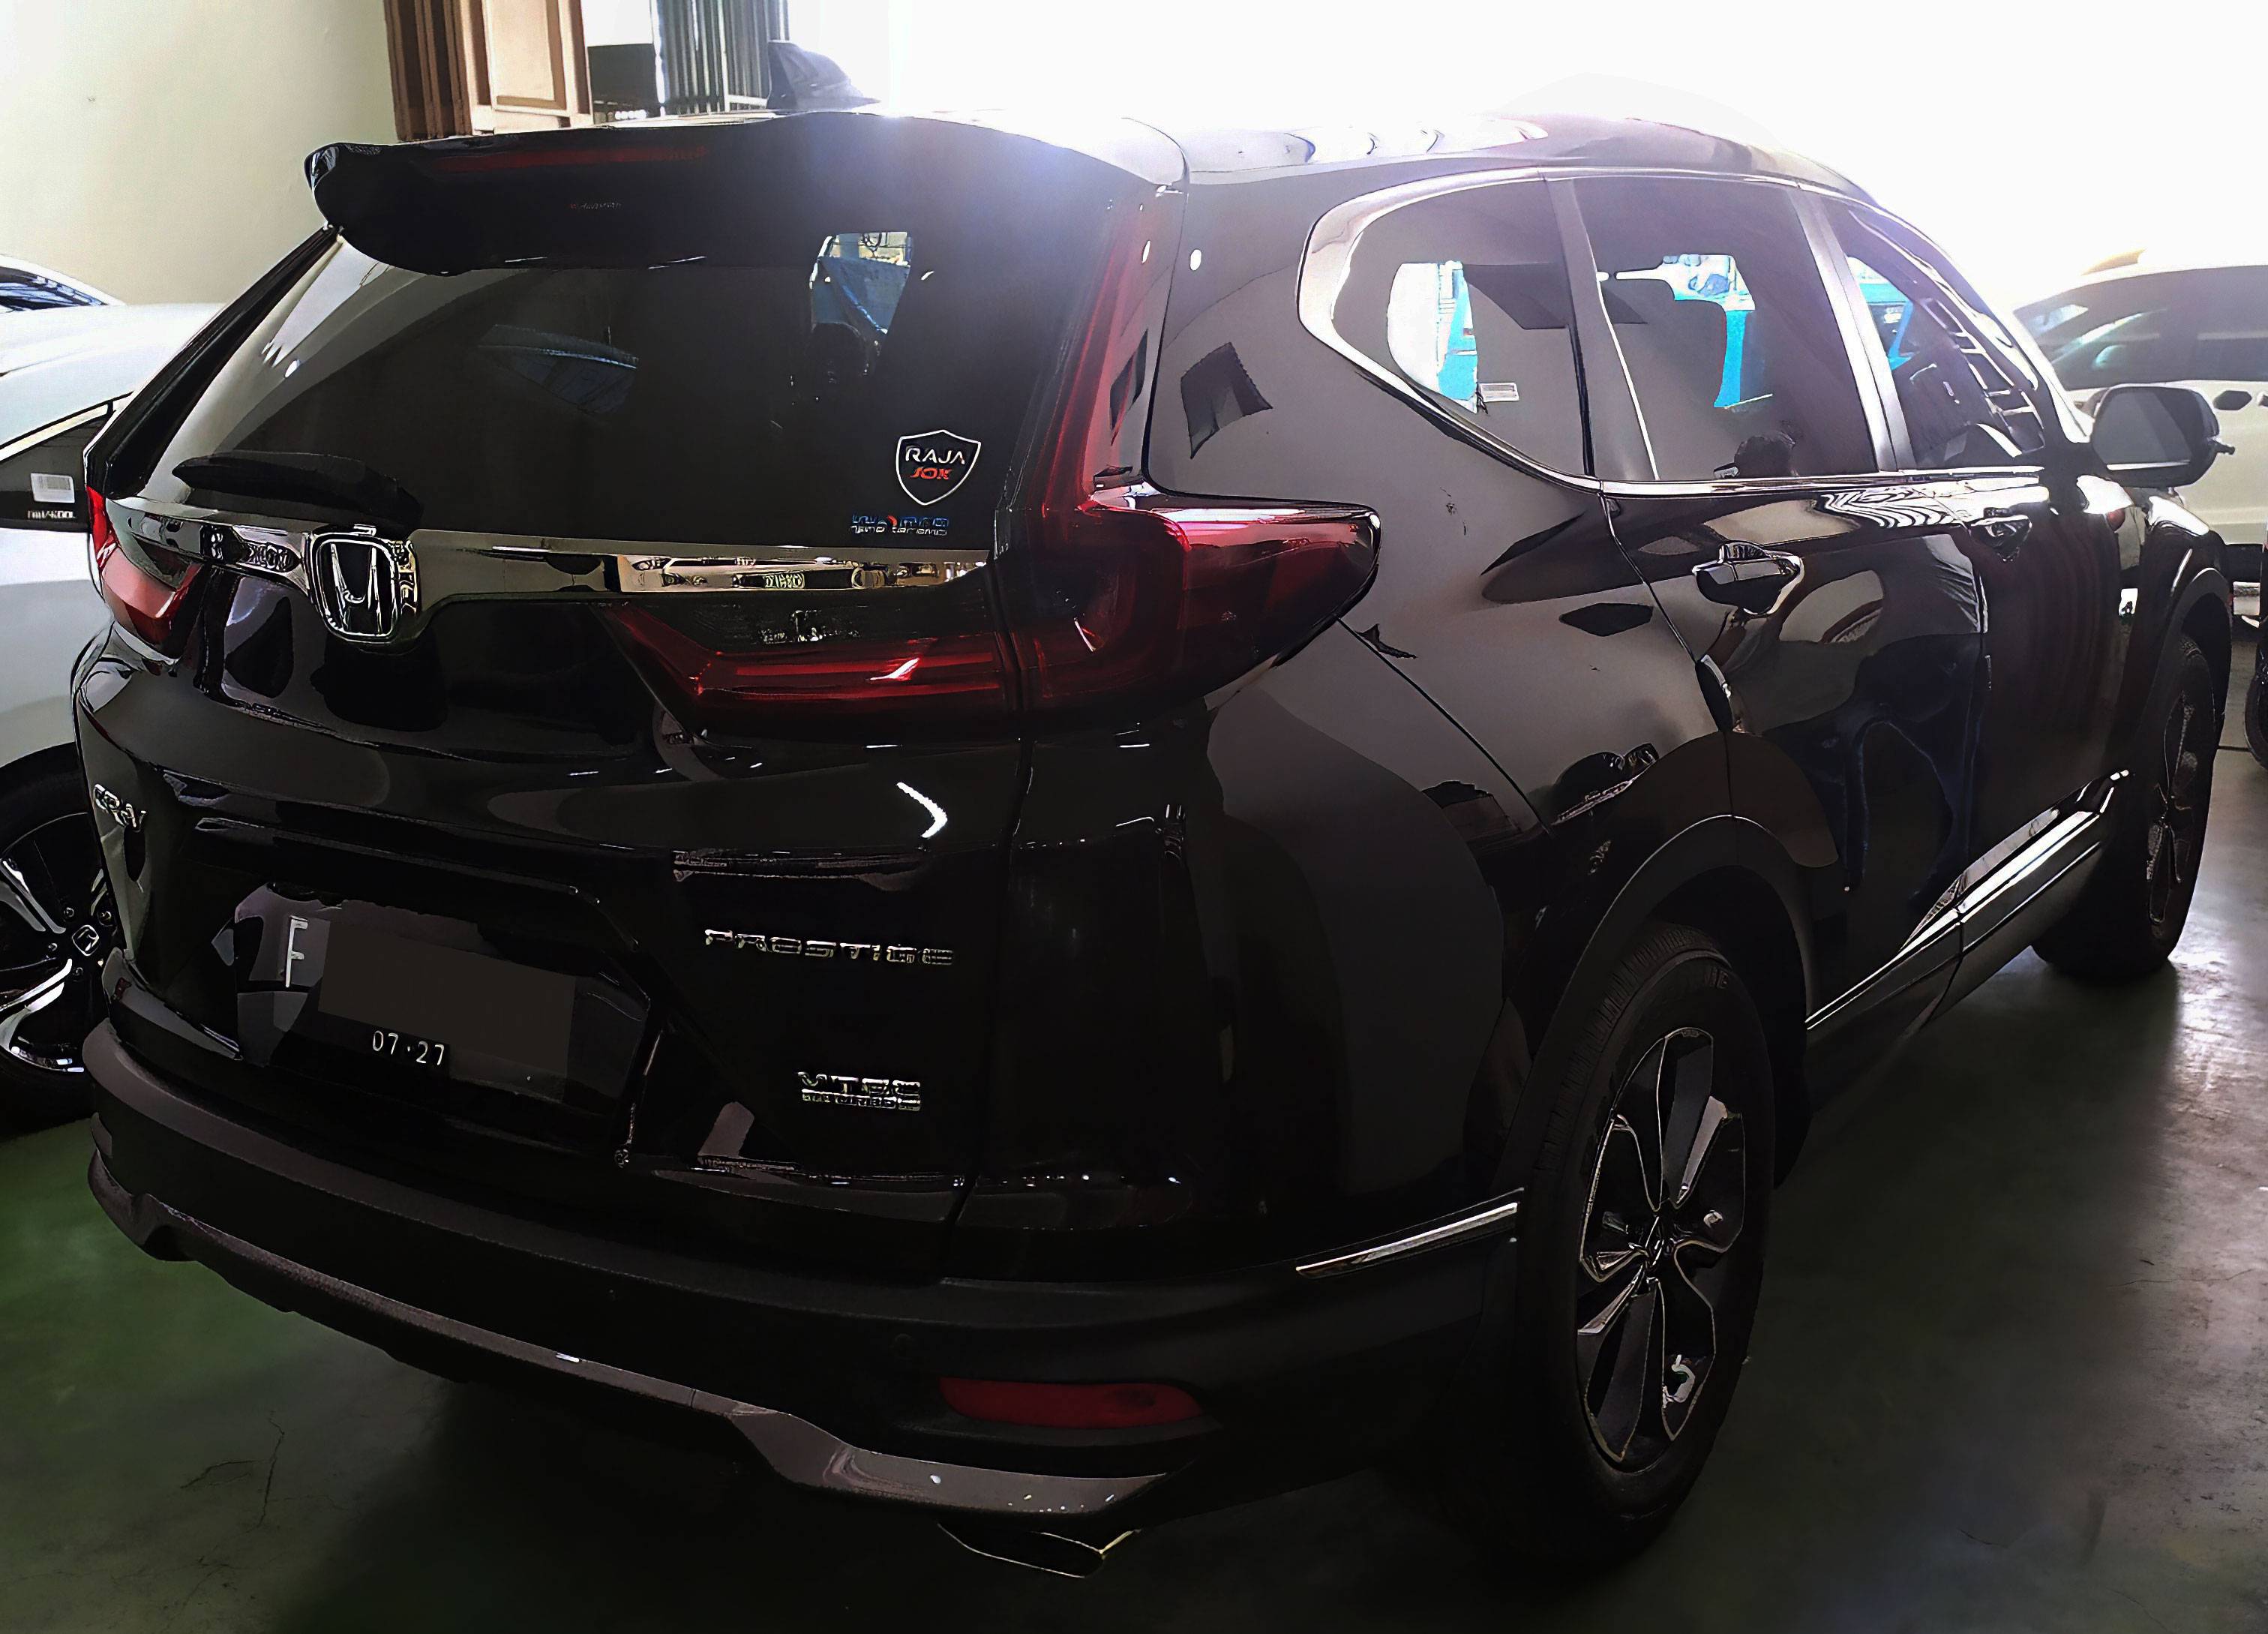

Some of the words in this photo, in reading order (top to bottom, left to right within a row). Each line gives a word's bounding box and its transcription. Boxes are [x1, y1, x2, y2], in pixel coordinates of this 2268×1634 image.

[905, 448, 965, 464] RAJA
[285, 915, 309, 988] F
[704, 929, 955, 965] PRESTIGE
[797, 1071, 921, 1097] VTEC
